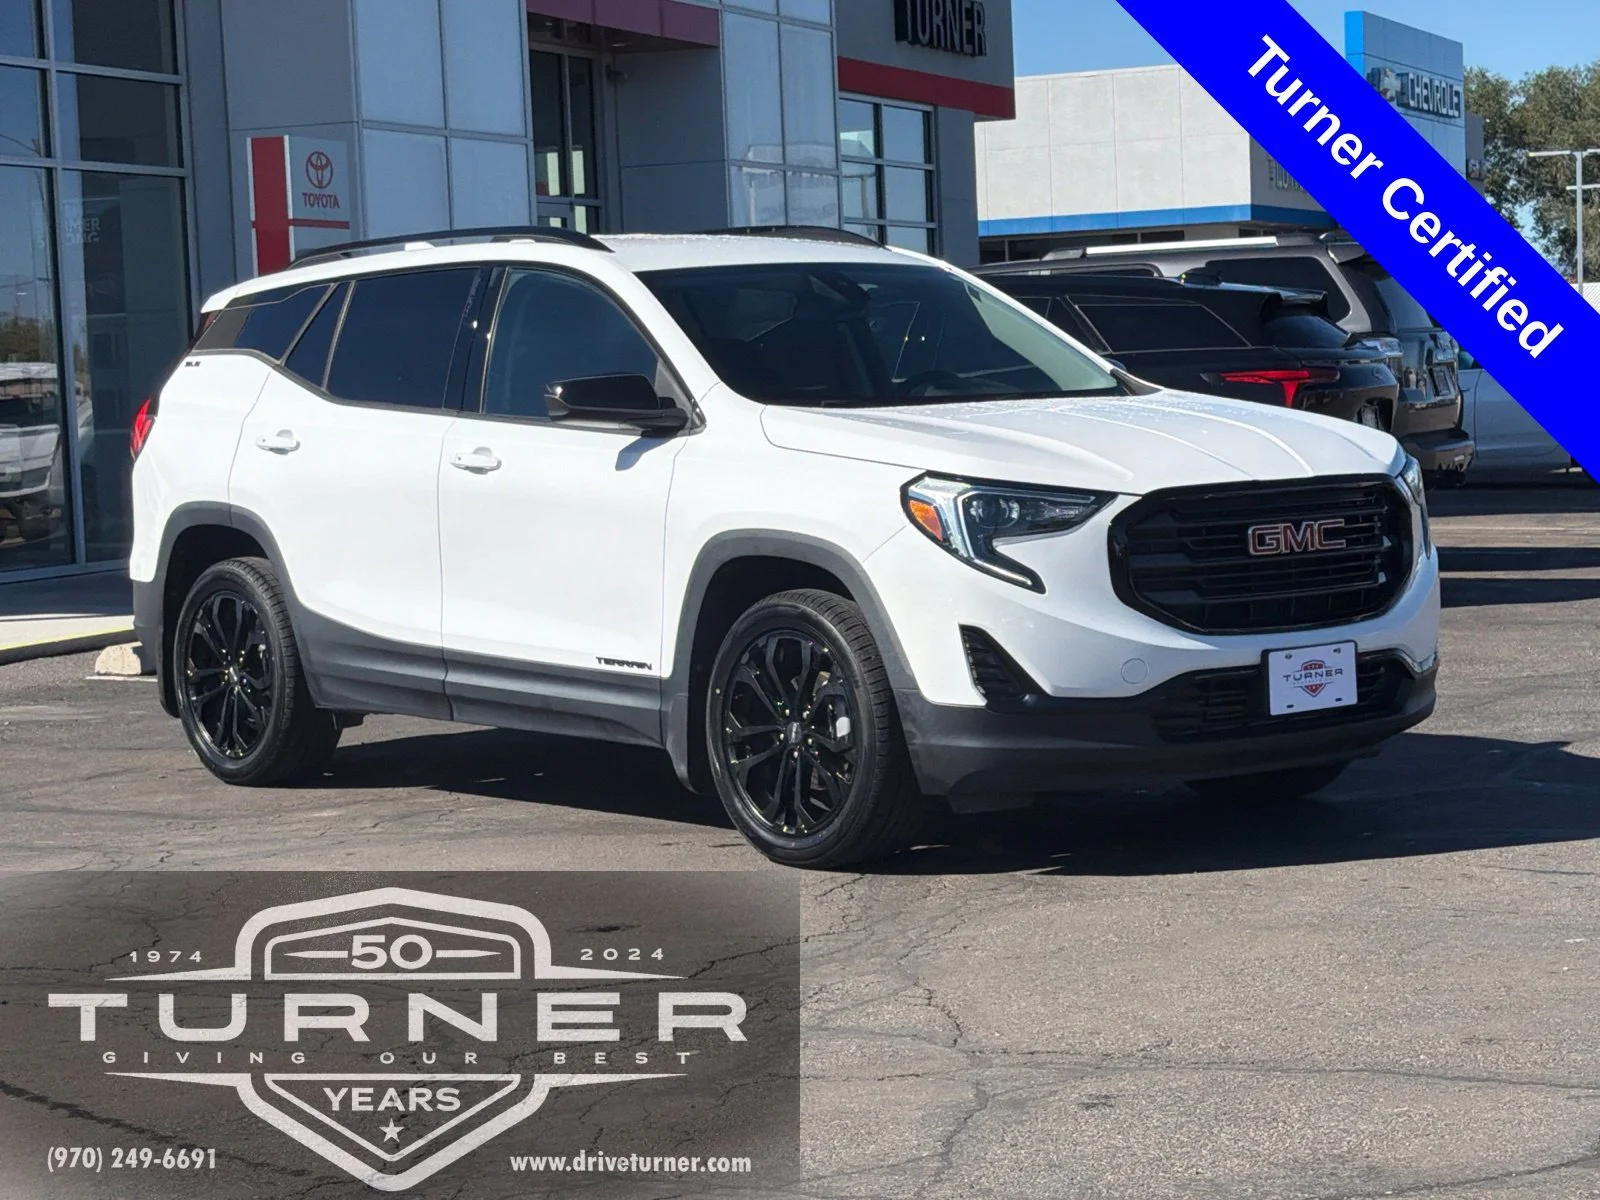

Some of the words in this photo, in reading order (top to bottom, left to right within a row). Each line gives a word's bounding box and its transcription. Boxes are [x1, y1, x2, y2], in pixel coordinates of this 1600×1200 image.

[894, 0, 987, 57] TURNER
[302, 192, 341, 209] TOYOTA
[1248, 518, 1346, 556] GMC
[595, 656, 652, 671] TERRAIN
[1282, 667, 1344, 683] TURNER
